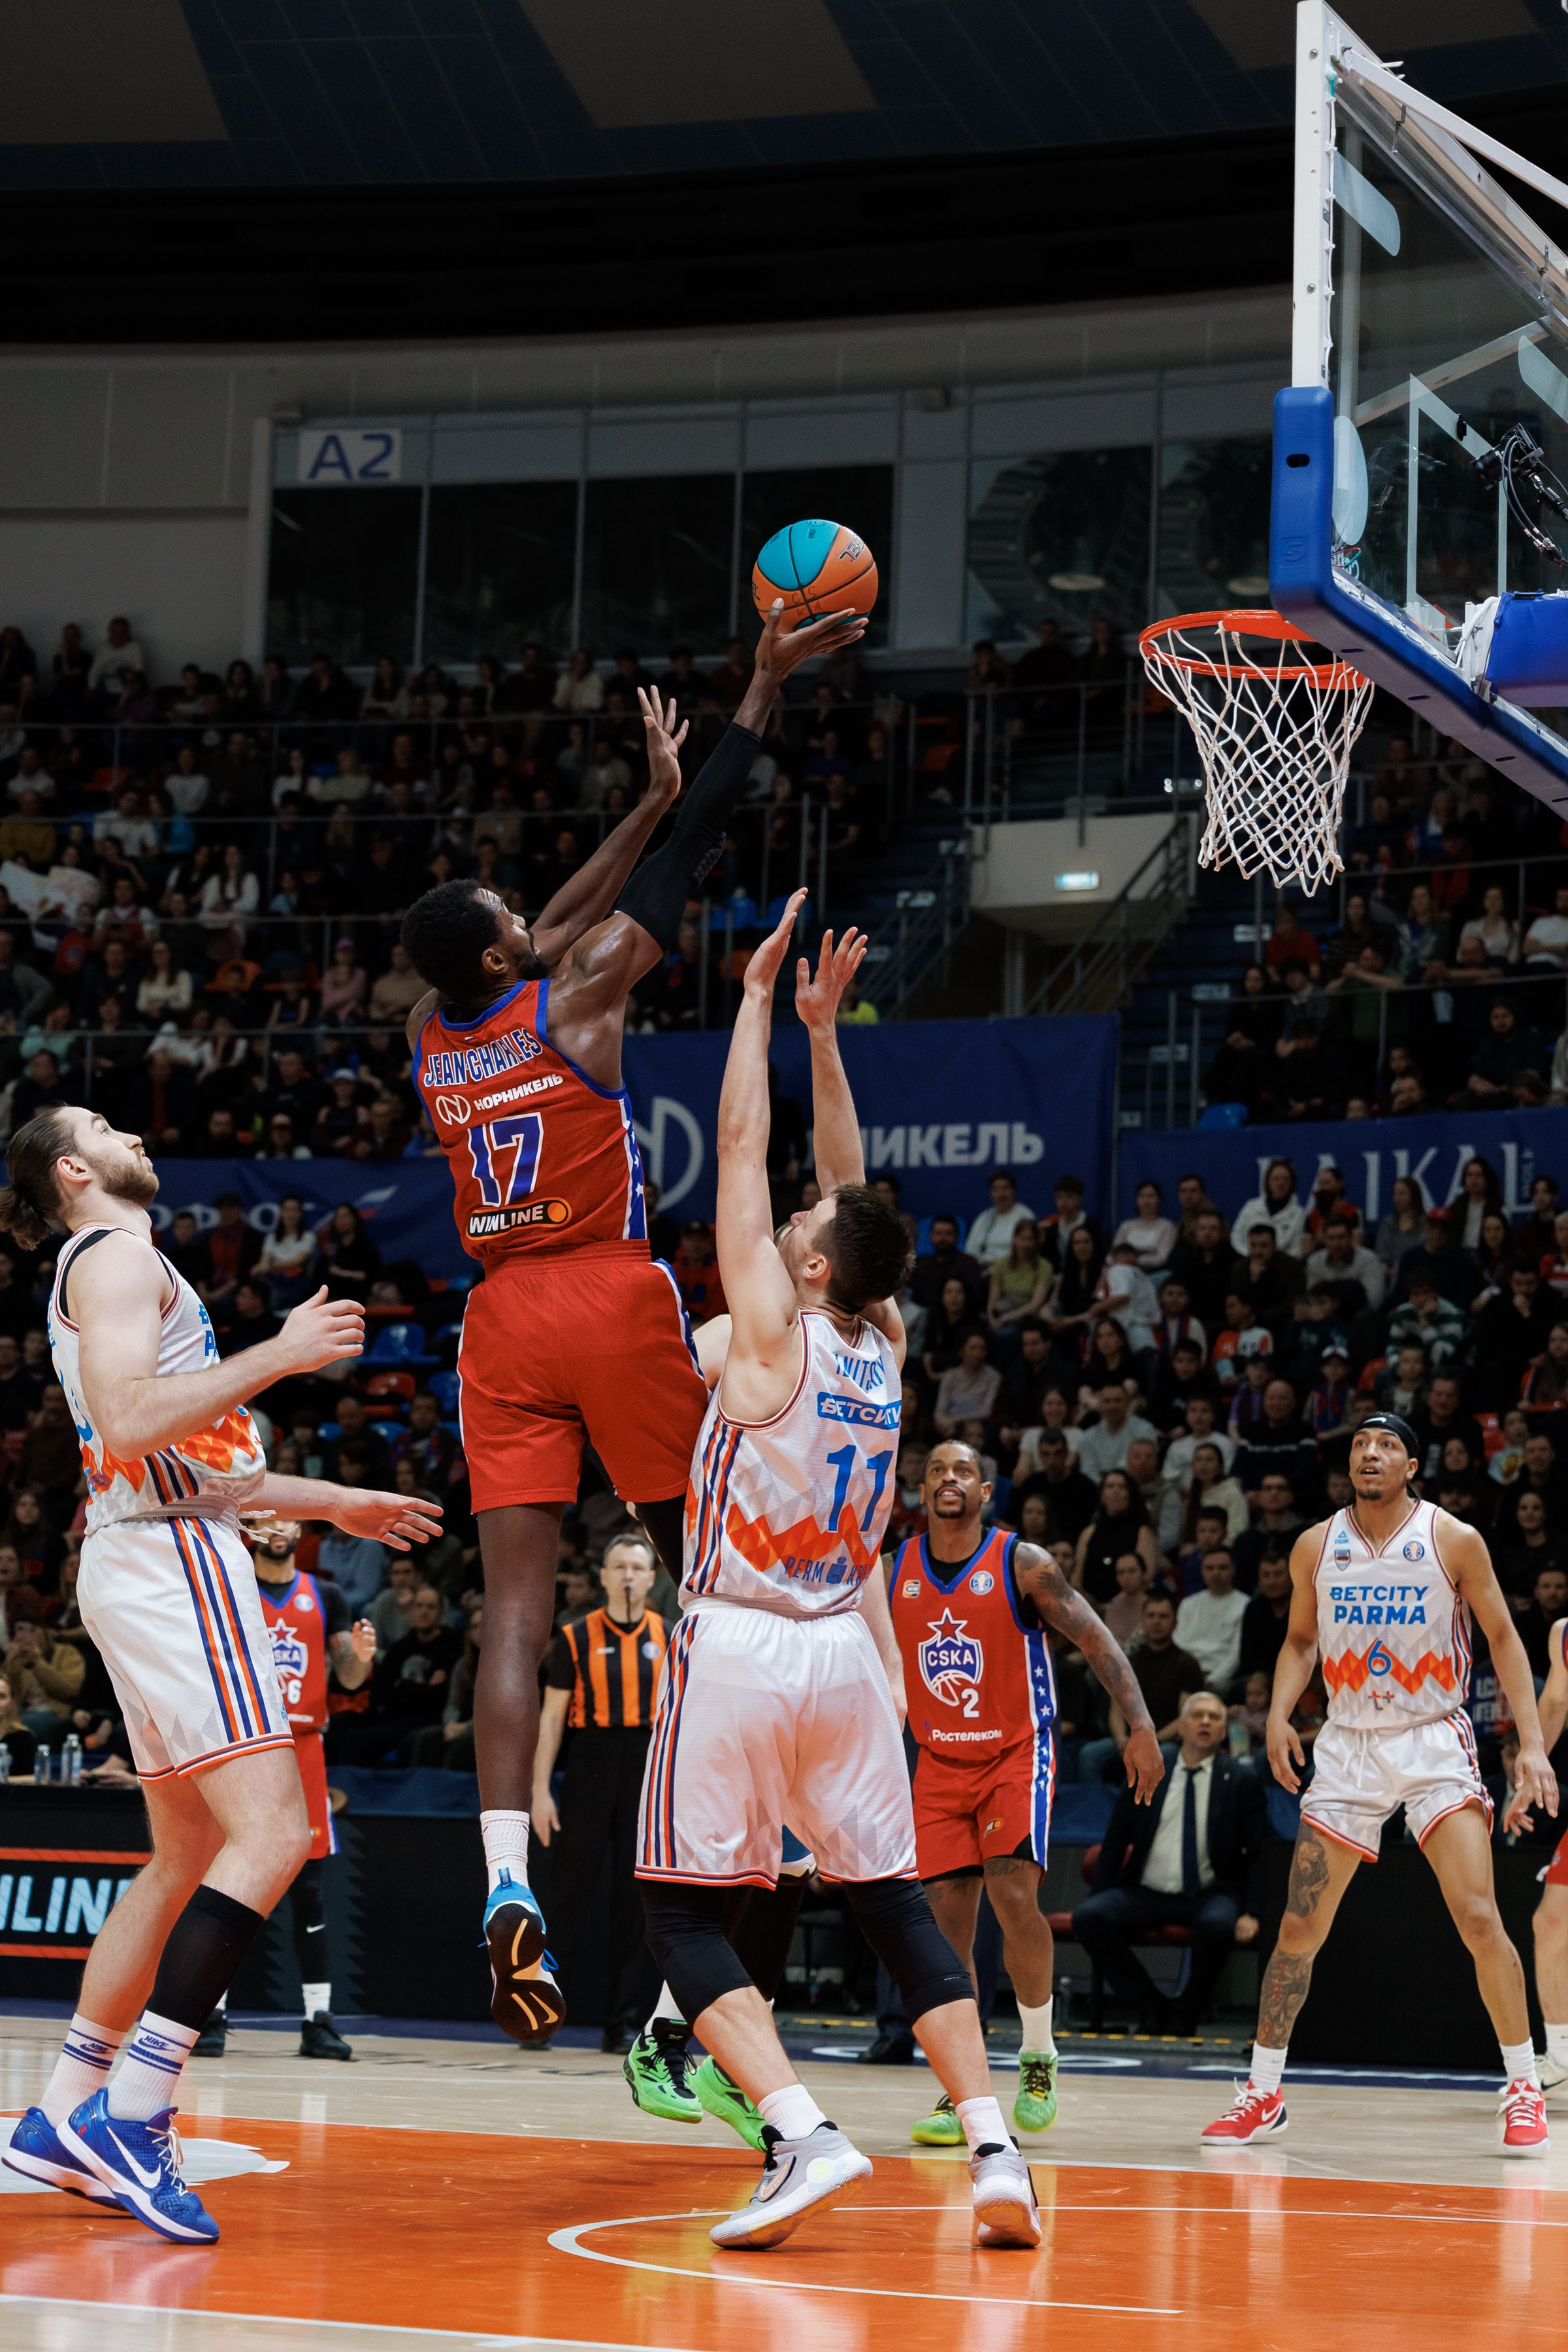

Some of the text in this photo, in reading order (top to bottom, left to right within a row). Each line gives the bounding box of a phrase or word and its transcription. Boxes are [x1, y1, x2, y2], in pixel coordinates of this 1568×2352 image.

[308, 434, 393, 480] A2
[467, 1112, 544, 1207] 17
[803, 1122, 1046, 1170] ИКЕЛЬ
[469, 1204, 544, 1233] WINLINE
[826, 1444, 894, 1533] 11
[784, 1556, 826, 1584] PERM
[1330, 1586, 1429, 1602] BETCITY
[1334, 1605, 1427, 1625] PARMA
[273, 1649, 301, 1663] SKA
[928, 1649, 975, 1667] CSKA
[1367, 1640, 1392, 1677] 6
[287, 1678, 302, 1705] 6
[961, 1687, 980, 1719] 2
[932, 1729, 1003, 1742] Ростелеком
[88, 2043, 109, 2053] NIKE
[144, 2035, 169, 2048] NIKE
